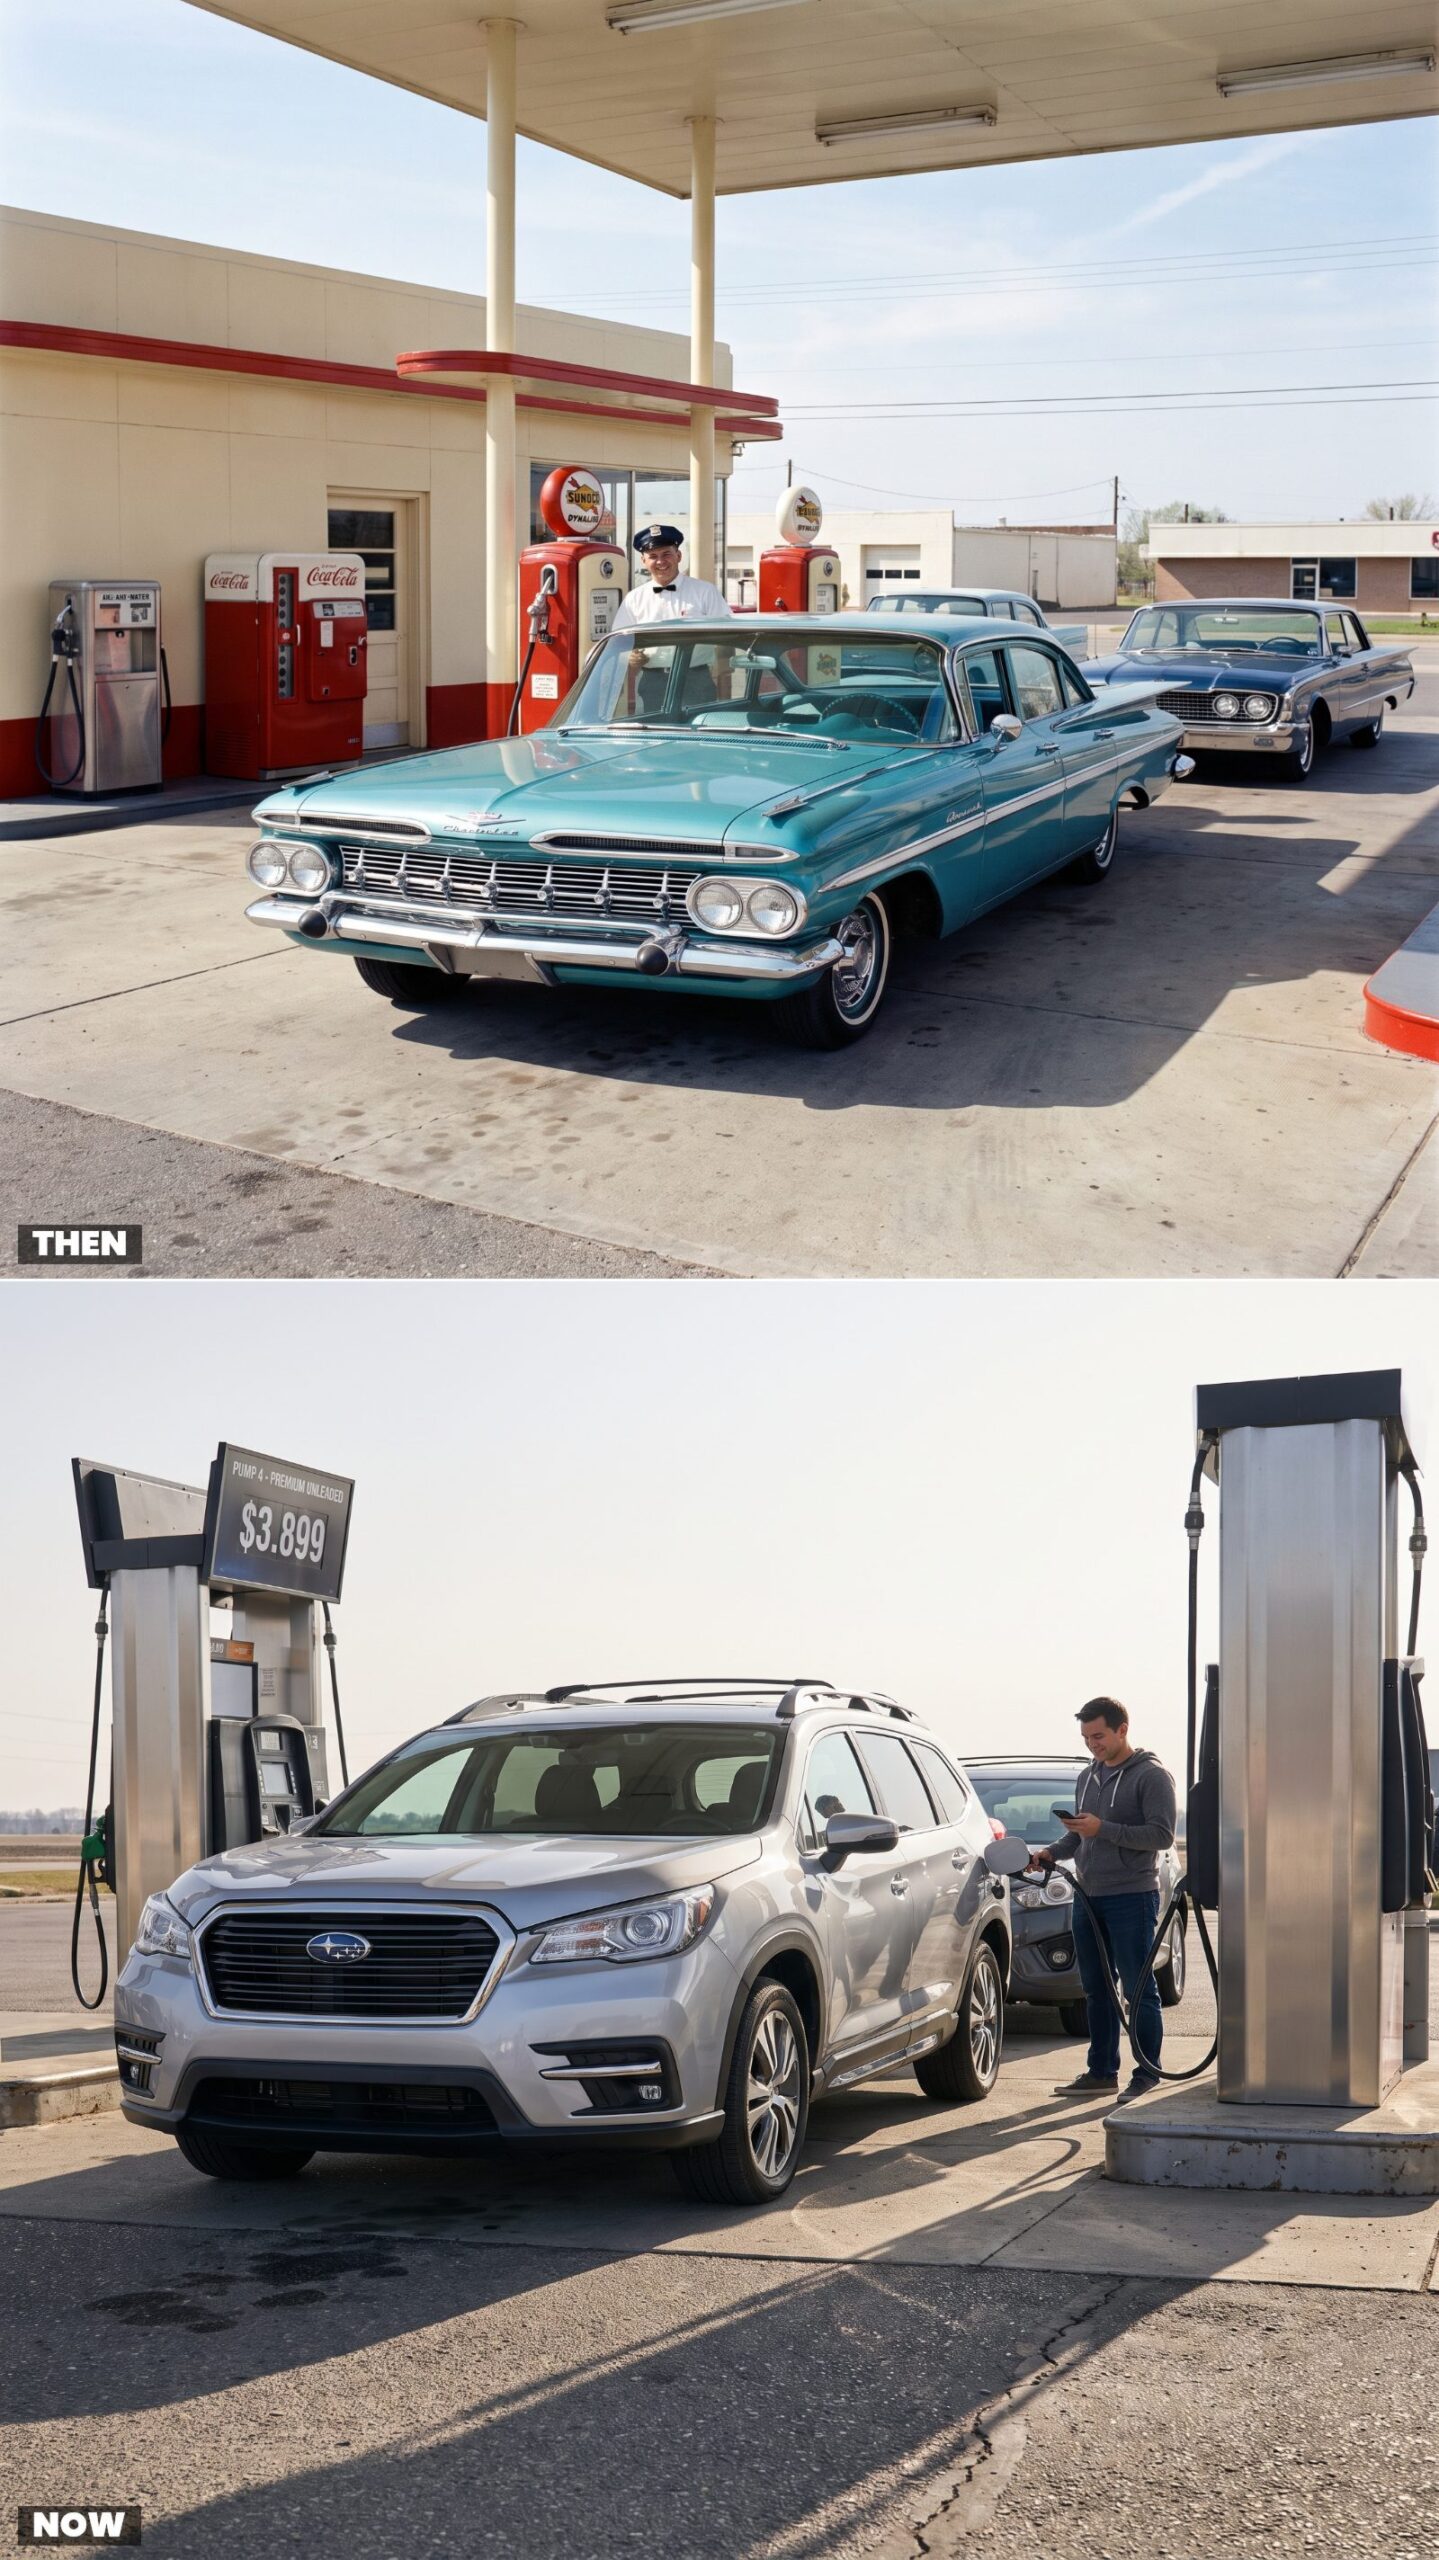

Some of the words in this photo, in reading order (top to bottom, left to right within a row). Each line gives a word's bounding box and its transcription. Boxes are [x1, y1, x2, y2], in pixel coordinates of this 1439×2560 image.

[210, 573, 249, 589] Coca-Cola
[307, 566, 359, 586] Coca-Cola
[232, 1461, 257, 1479] PUMP
[258, 1468, 264, 1482] 4
[270, 1472, 306, 1493] PREMIUM
[306, 1481, 344, 1503] UNLEADED
[240, 1499, 325, 1562] $3.899
